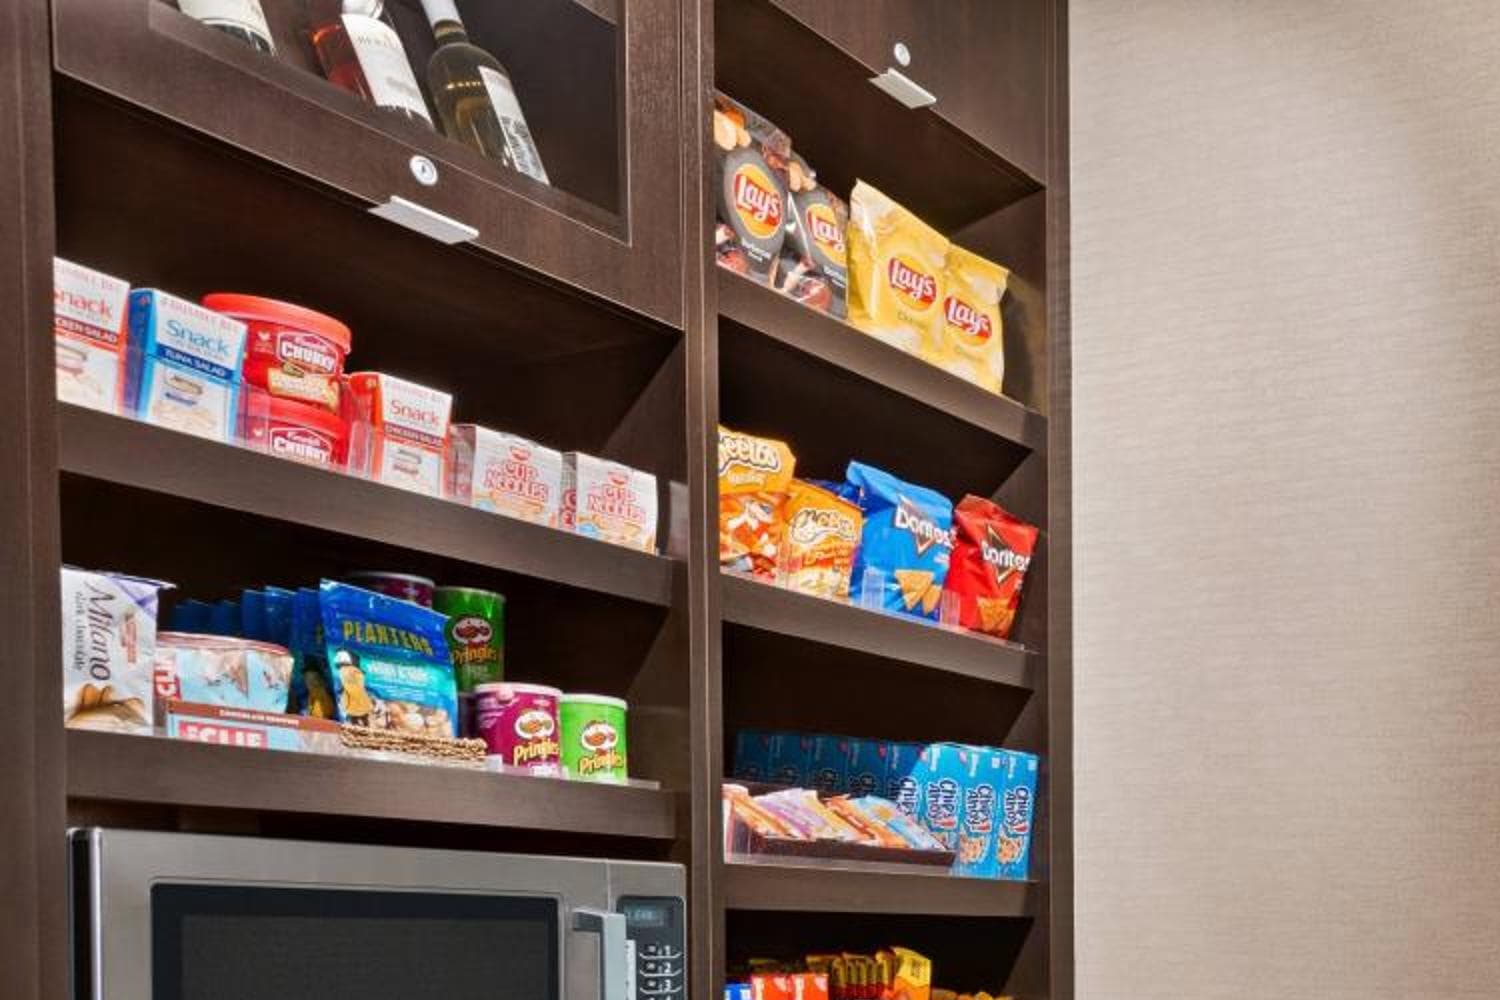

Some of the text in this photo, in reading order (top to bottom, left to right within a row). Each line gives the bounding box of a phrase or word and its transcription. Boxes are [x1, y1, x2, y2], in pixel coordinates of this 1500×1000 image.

[737, 175, 778, 221] Lay's
[812, 213, 845, 252] Lay
[891, 260, 933, 300] Lay's
[948, 298, 989, 334] Lay's
[167, 319, 231, 356] Snack
[390, 400, 440, 426] Snack
[84, 581, 115, 680] Milano
[343, 620, 433, 656] PLANTERS
[513, 739, 560, 767] Pringles
[578, 750, 624, 777] Pringles
